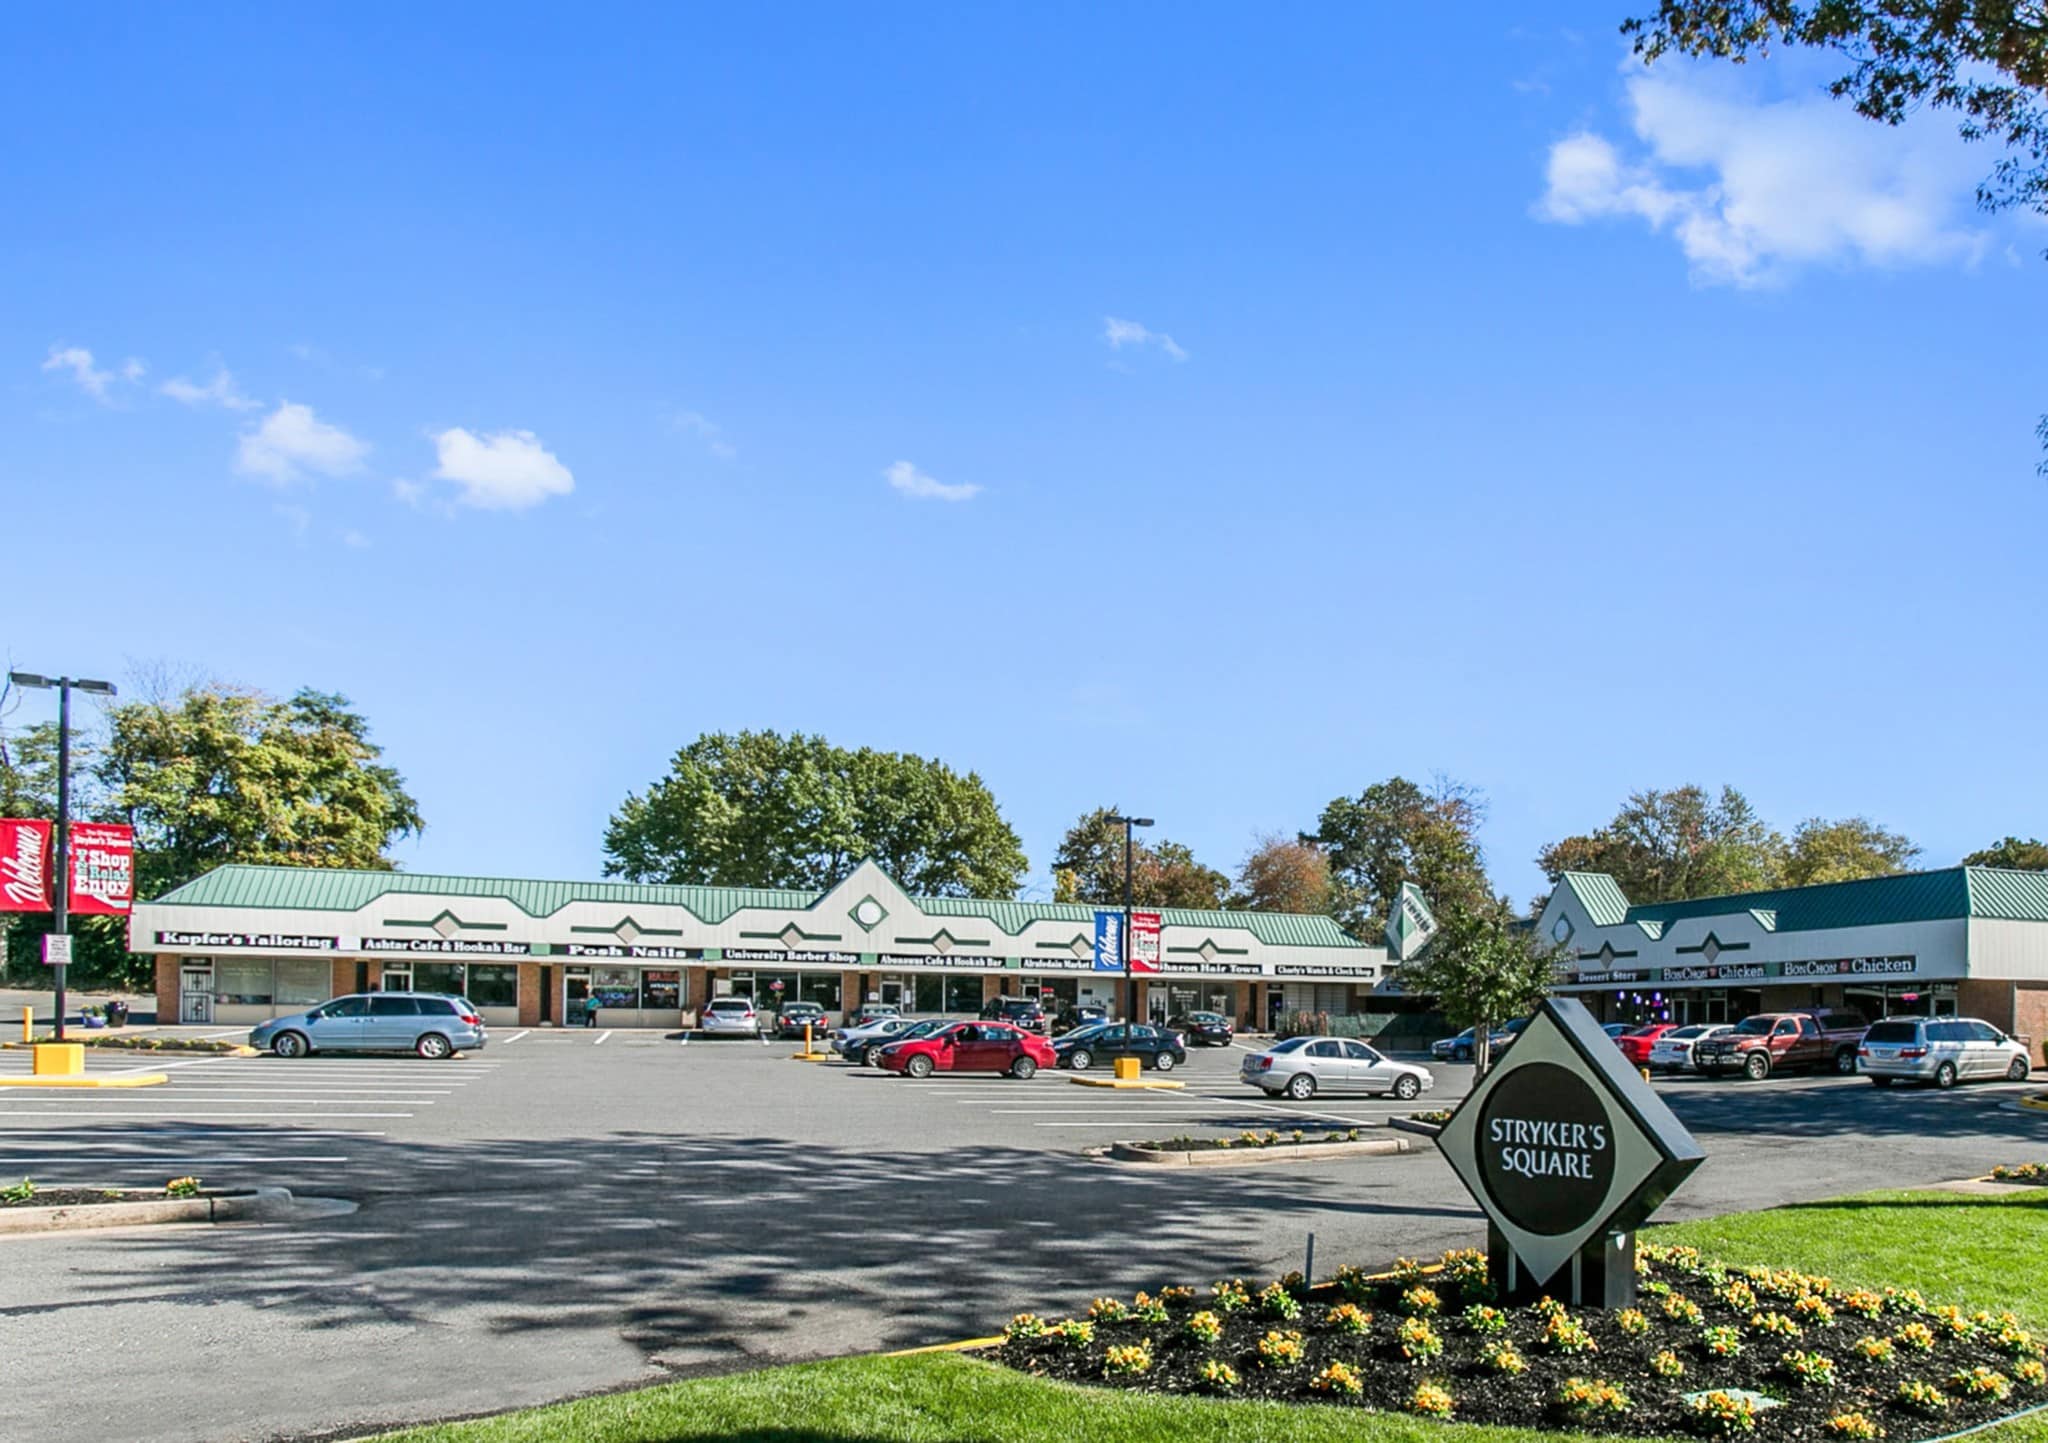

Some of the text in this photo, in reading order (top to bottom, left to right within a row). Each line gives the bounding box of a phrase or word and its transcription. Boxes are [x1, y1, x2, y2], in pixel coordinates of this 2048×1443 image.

[0, 825, 43, 904] Welcome
[89, 849, 129, 870] Shop
[74, 875, 130, 895] Enjoy
[247, 934, 332, 949] Tailoring
[410, 940, 440, 951] Cafe
[441, 941, 451, 952] &
[454, 942, 501, 953] Hookah
[503, 943, 527, 954] Bar
[568, 944, 687, 959] Posh Nails
[726, 950, 857, 964] University Barber Shop
[1200, 963, 1227, 974] Hair
[1229, 964, 1260, 974] Town
[1718, 966, 1764, 979] Chicken
[1851, 956, 1913, 974] Chicken
[1491, 1118, 1607, 1151] STRYKER'S
[1502, 1147, 1593, 1178] SQUARE
